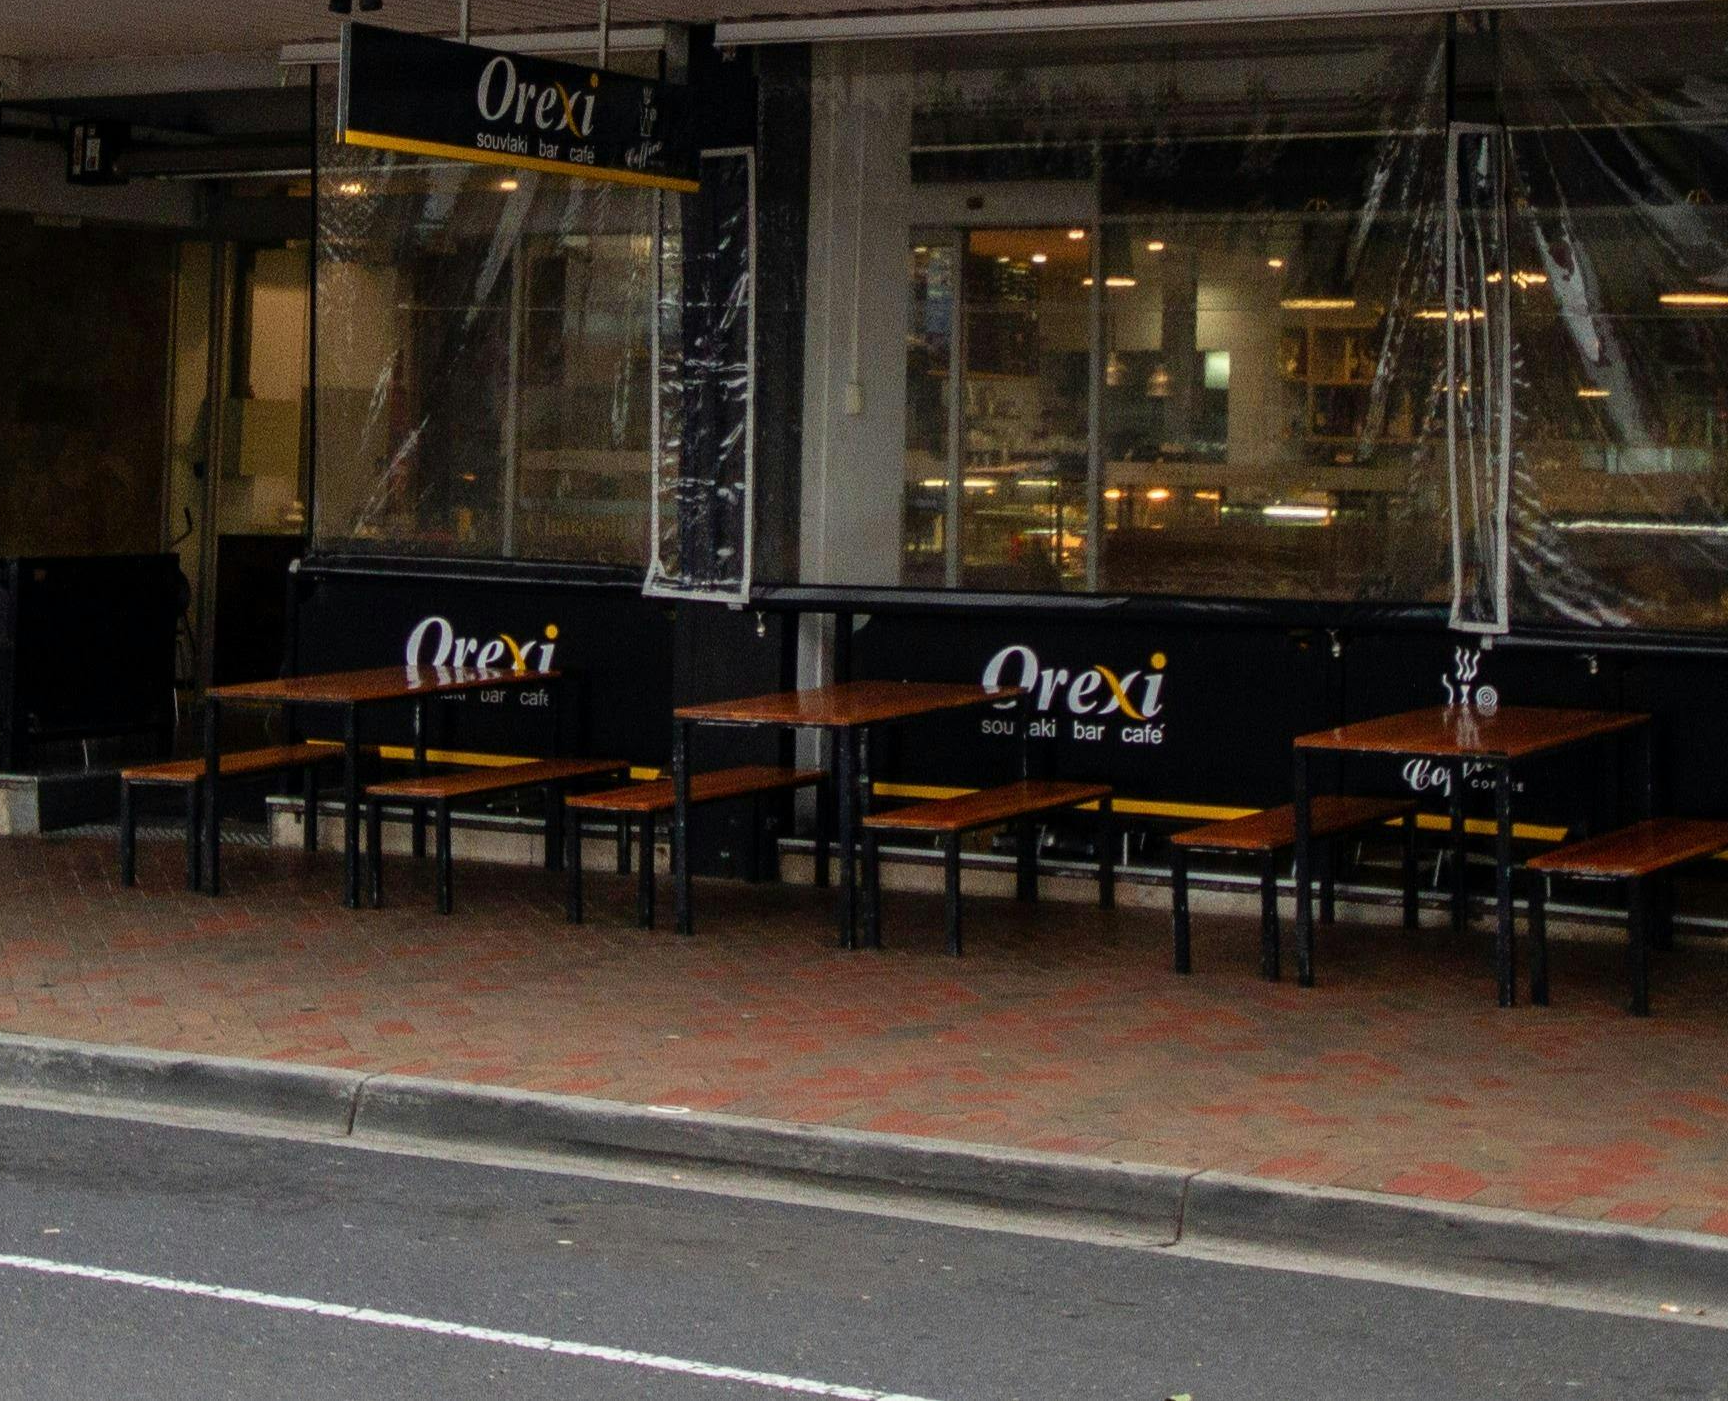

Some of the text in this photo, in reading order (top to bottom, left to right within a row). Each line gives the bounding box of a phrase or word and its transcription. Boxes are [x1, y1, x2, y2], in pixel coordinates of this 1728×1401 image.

[477, 55, 600, 139] Orexi
[476, 130, 595, 165] souvlaki bar café
[982, 645, 1167, 721] Orexi
[981, 718, 1166, 745] souaki bar café
